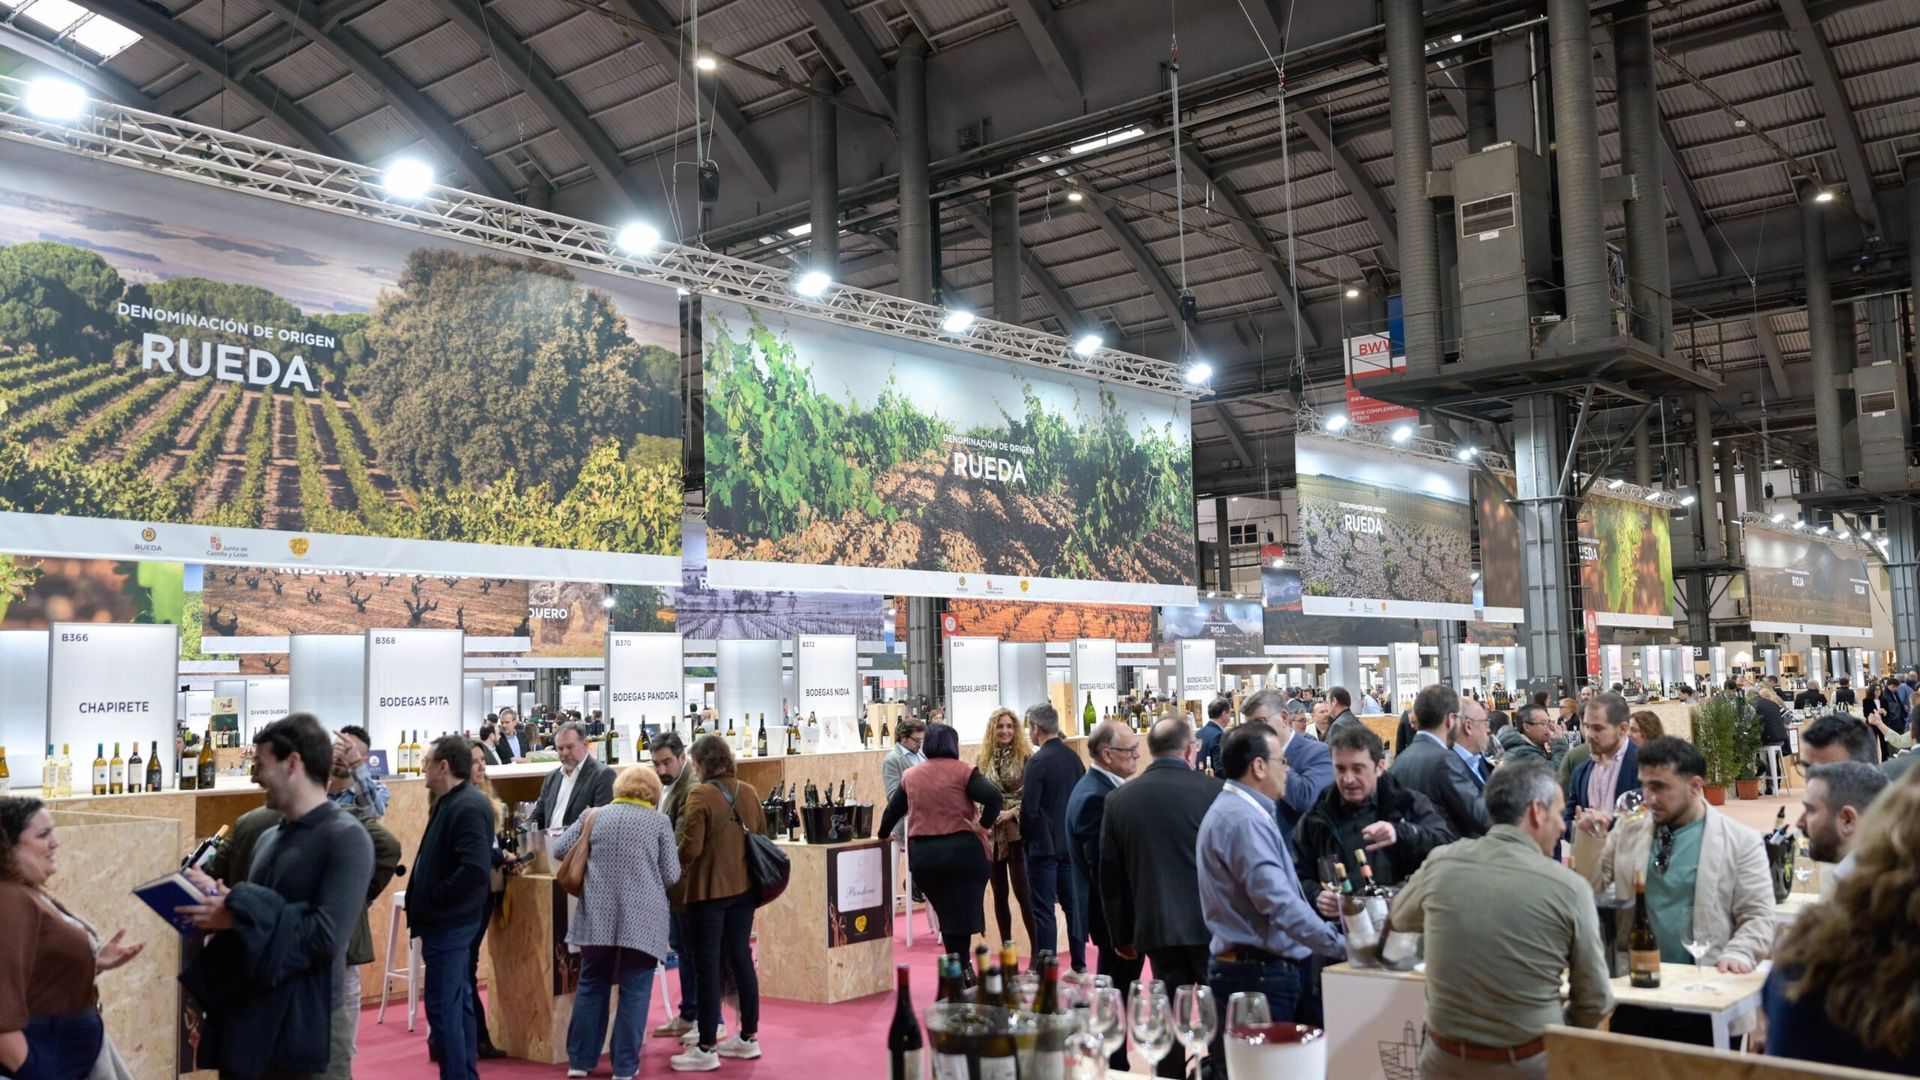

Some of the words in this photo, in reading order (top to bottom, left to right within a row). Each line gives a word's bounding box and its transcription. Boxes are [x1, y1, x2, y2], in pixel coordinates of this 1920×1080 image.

[118, 302, 248, 335] DENOMINACIÓN
[253, 325, 274, 339] DE
[278, 329, 335, 349] ORIGEN
[142, 332, 315, 392] RUEDA
[999, 442, 1009, 451] DE
[1009, 444, 1035, 455] ORIGEN
[953, 451, 1028, 485] RUEDA
[1344, 513, 1384, 535] RUEDA
[134, 544, 162, 552] RUEDA
[1578, 546, 1599, 560] UEDA
[61, 633, 89, 642] B366
[375, 636, 396, 645] B368
[805, 688, 833, 697] BODEGAS
[834, 687, 850, 696] NIDIA
[952, 685, 973, 693] BODEGAS
[973, 684, 987, 692] JAVIER
[379, 696, 427, 707] BODEGAS
[429, 695, 450, 706] PITA
[613, 692, 646, 702] BODEGAS
[647, 691, 679, 701] PANDORA
[79, 701, 149, 714] CHAPIRETE
